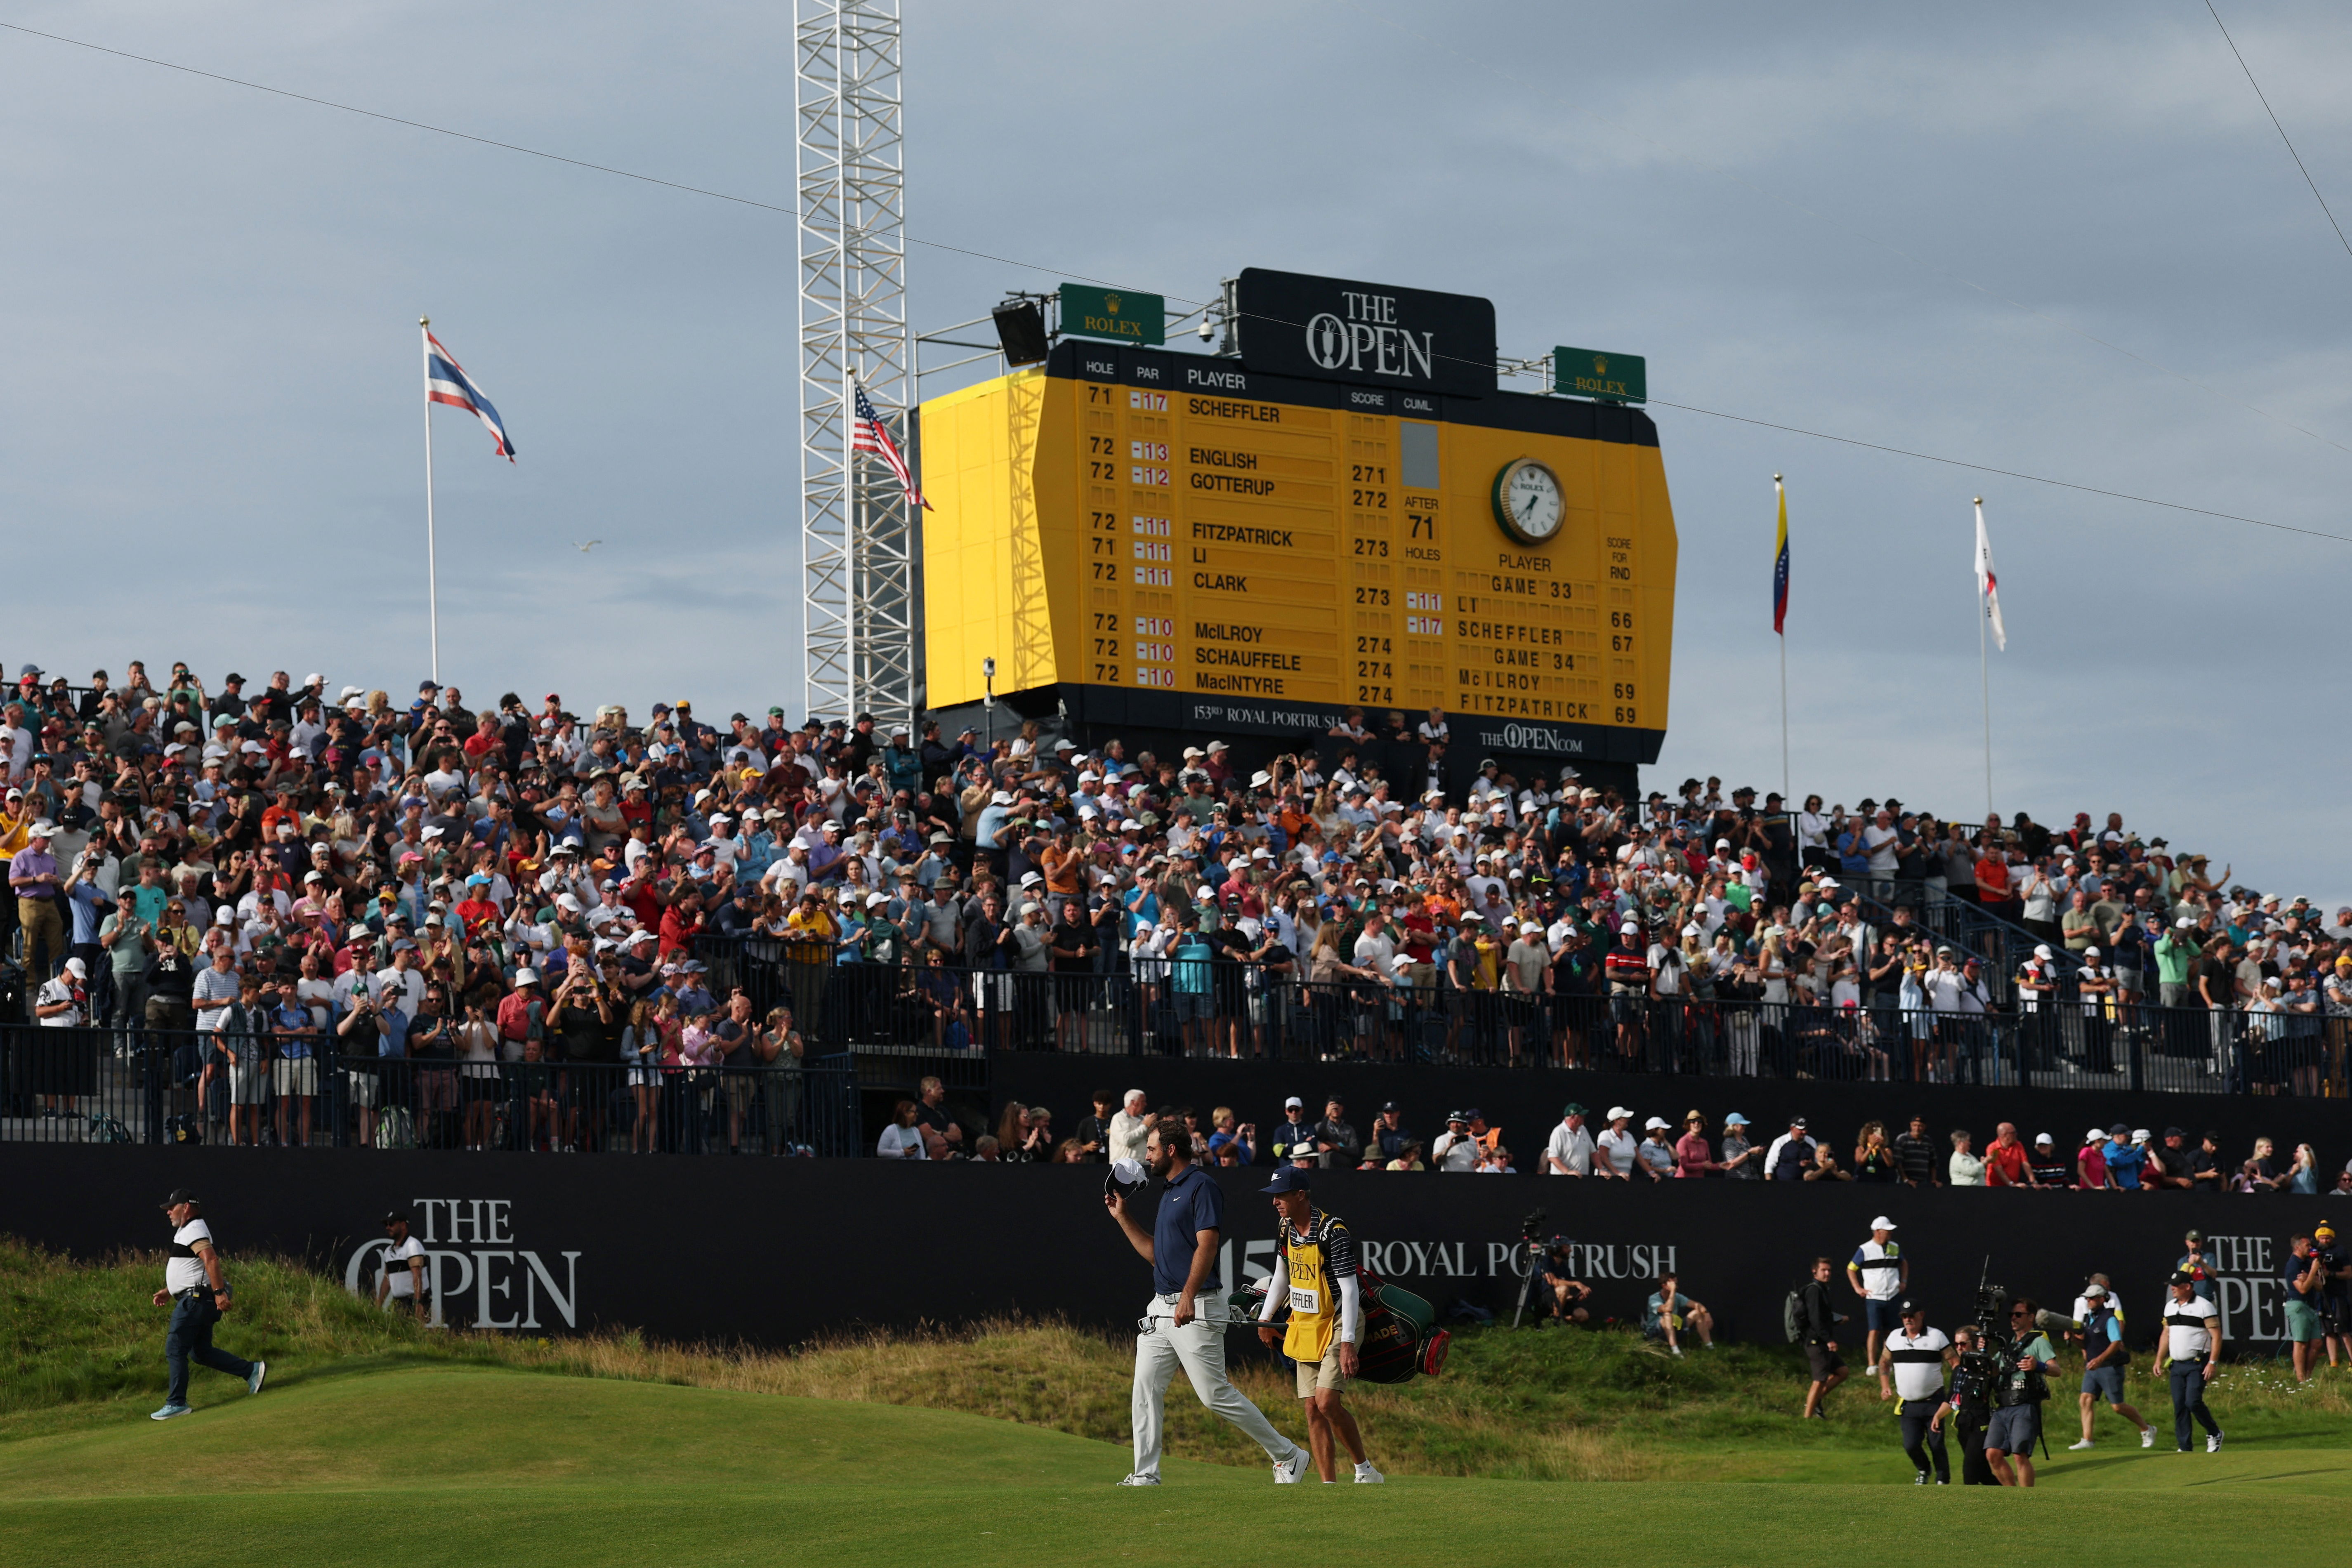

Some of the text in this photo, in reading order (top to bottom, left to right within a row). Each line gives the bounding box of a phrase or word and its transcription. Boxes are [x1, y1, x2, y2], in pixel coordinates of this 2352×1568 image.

[1342, 291, 1397, 324] THE
[1084, 316, 1142, 336] ROLEX
[1306, 313, 1434, 380] OPEN
[1087, 361, 1113, 375] HOLE
[1137, 367, 1159, 380] PAR
[1188, 370, 1246, 390] PLAYER
[1351, 392, 1384, 406] SCORE
[1576, 377, 1626, 395] ROLEX
[1089, 387, 1280, 423] 71 -17 SCHEFFLER
[1090, 437, 1385, 483] 72 -13 ENGLISH 271
[1091, 462, 1387, 508] 72 -12 GOTTERUP 272
[1520, 483, 1544, 491] ROLEX
[1404, 497, 1439, 509] AFTER
[1092, 512, 1388, 556] 72 -11 FITZPATRICK 273
[1408, 515, 1433, 539] 71
[1092, 538, 1206, 564] 71 -11 LI
[1406, 548, 1440, 561] HOLES
[1607, 537, 1631, 549] SCORE
[1613, 552, 1627, 563] FOR
[1499, 554, 1551, 573] PLAYER
[1610, 567, 1630, 580] RND
[1093, 563, 1389, 606] 72 -11 CLARK 273
[1492, 576, 1572, 599] GAME 33
[1408, 592, 1440, 610] -11
[1611, 611, 1632, 629] 66
[1094, 613, 1392, 654] 72 -10 McILROY 274
[1409, 617, 1633, 652] -17 SCHEFFLER 67
[1095, 639, 1392, 679] 72 -10 SCHAUFFELE 274
[1495, 648, 1574, 670] GAME 34
[1095, 664, 1392, 704] 72 -10 MacINTYRE 274
[1459, 669, 1634, 700] McILROY 69
[1227, 707, 1269, 724] ROYAL
[1272, 711, 1342, 729] PORTRUSH
[1461, 693, 1635, 724] FITZPATRICK 69
[413, 1199, 514, 1243] THE
[1292, 1251, 1304, 1263] THE
[1361, 1241, 1477, 1276] ROYAL
[1487, 1243, 1676, 1279] PTRUSH
[2208, 1236, 2274, 1272] THE
[1292, 1292, 1314, 1309] EFFLER
